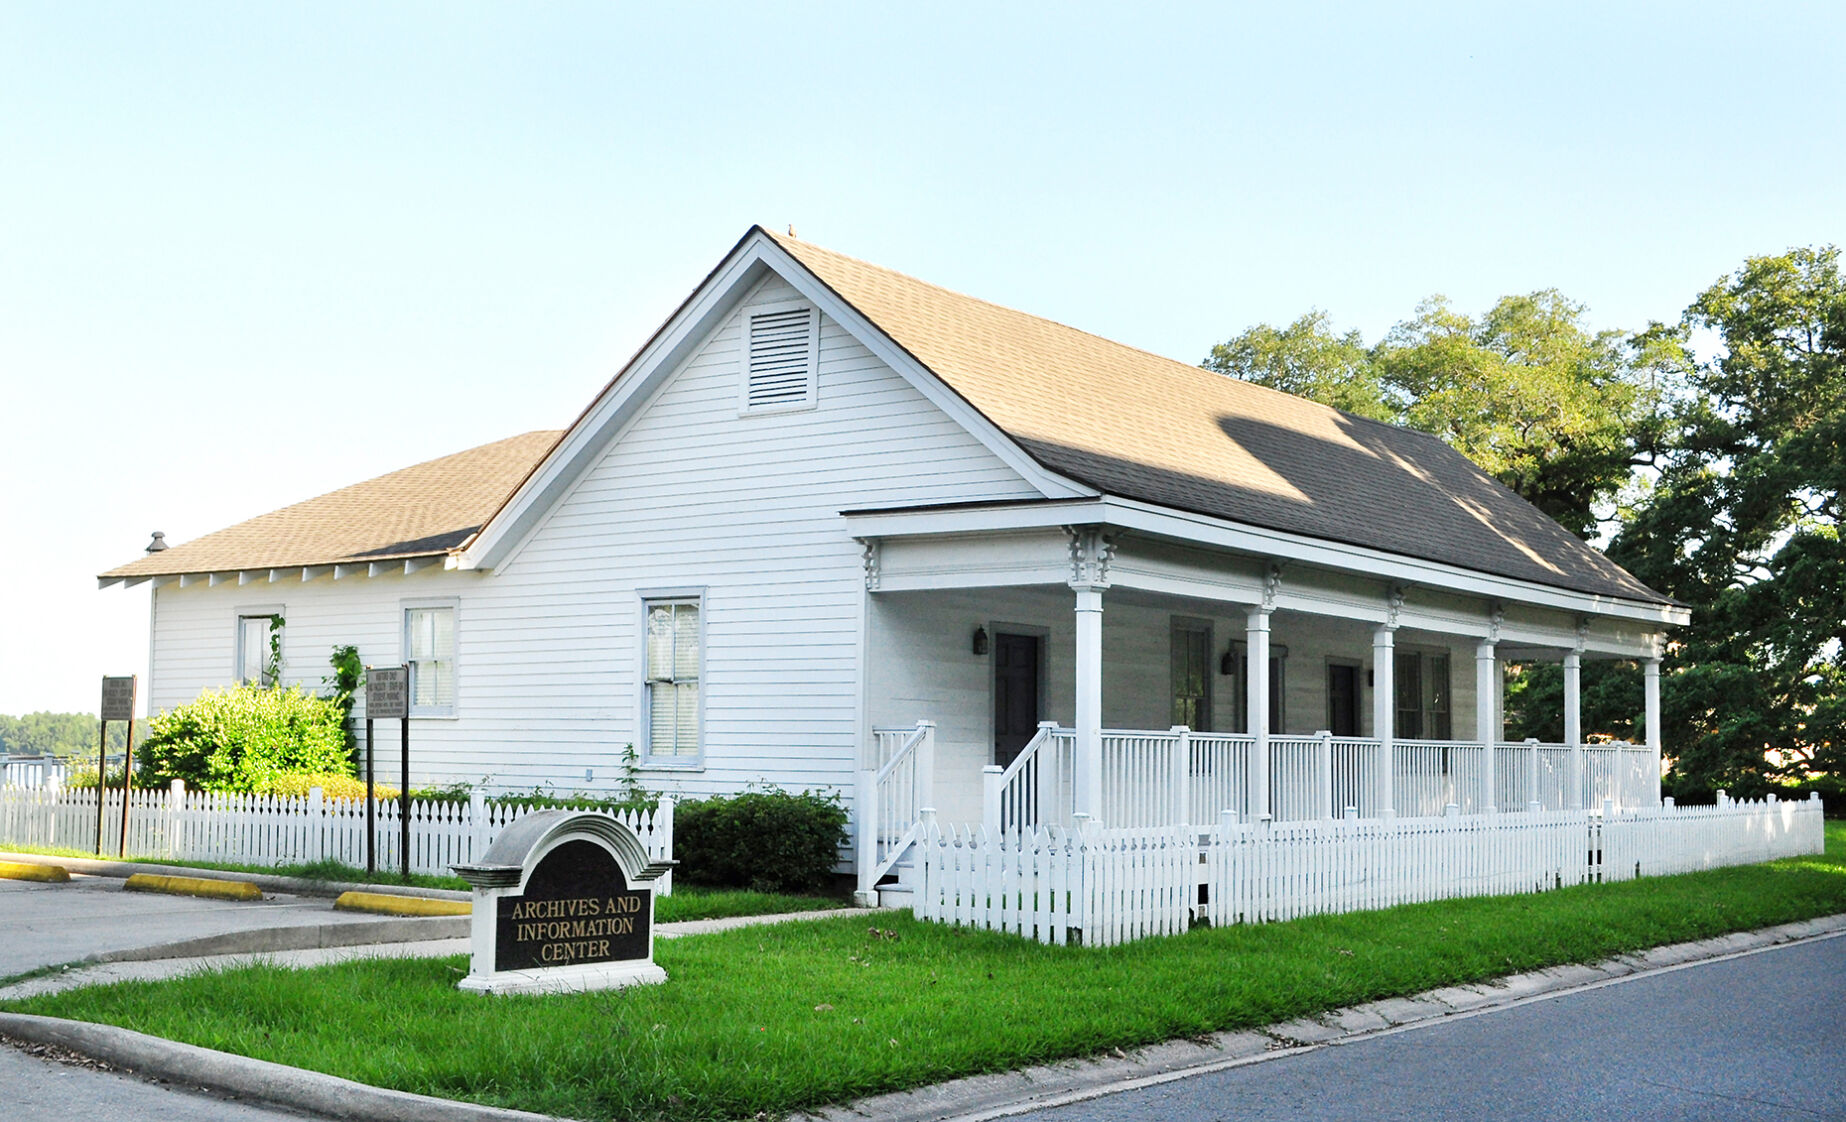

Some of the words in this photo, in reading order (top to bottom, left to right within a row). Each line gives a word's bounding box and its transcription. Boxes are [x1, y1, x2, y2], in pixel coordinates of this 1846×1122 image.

[511, 898, 600, 920] ARCHIVES
[604, 896, 641, 914] AND
[516, 917, 635, 942] INFORMATION
[541, 940, 610, 962] CENTER
